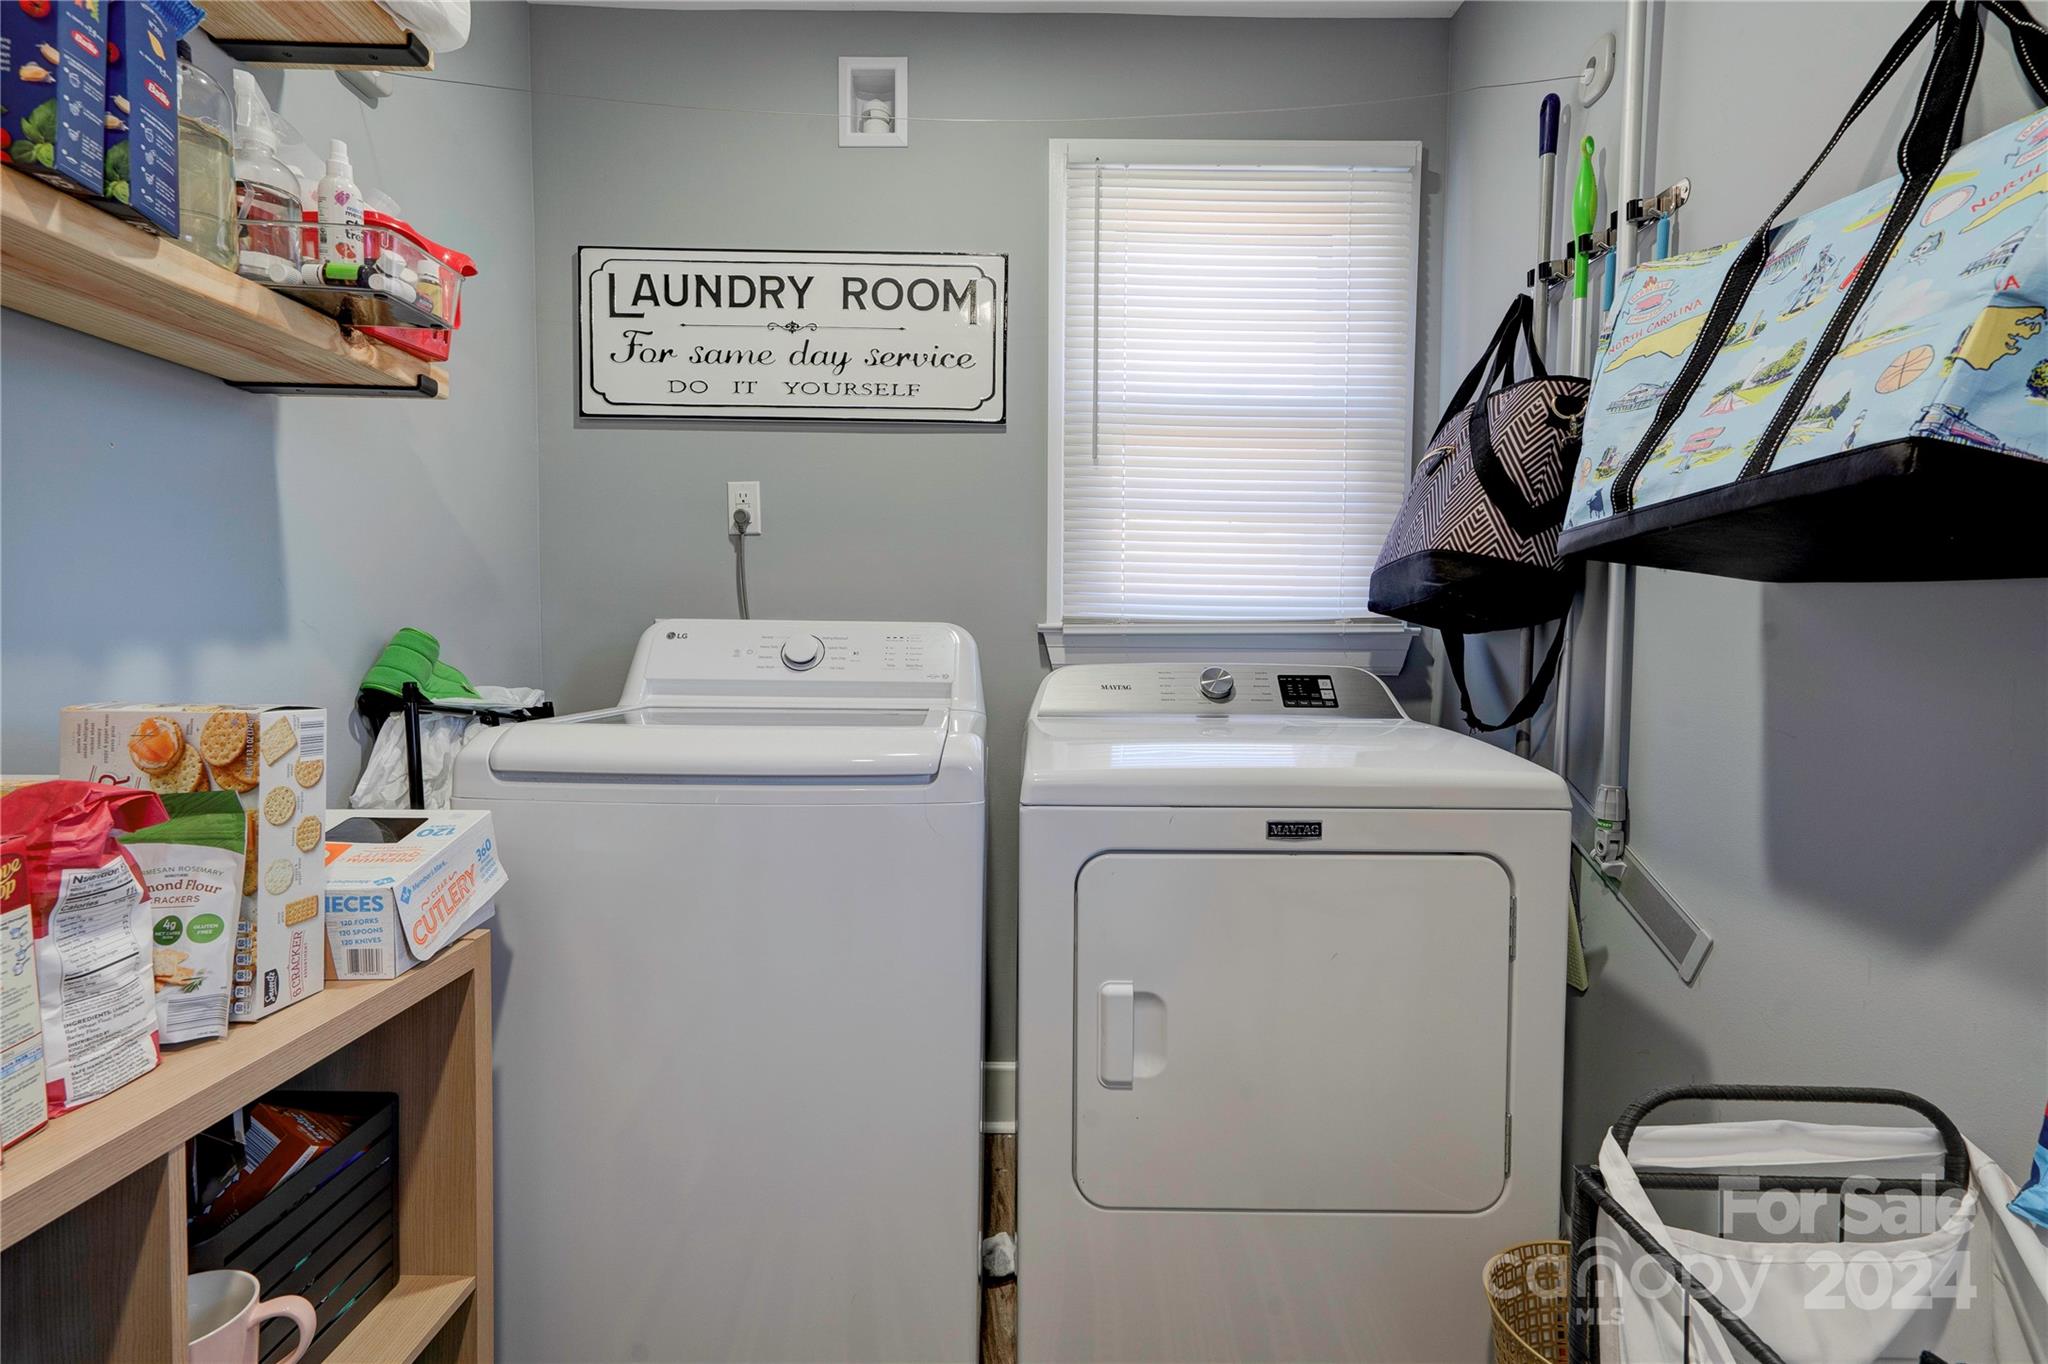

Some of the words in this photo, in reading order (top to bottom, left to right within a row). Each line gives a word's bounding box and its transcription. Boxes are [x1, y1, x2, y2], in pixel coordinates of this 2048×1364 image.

[608, 272, 814, 318] LAUNDRY
[842, 277, 978, 325] ROOM
[1647, 299, 1703, 333] CAROLINA
[609, 330, 678, 364] For
[689, 345, 776, 366] same
[788, 339, 852, 376] day
[864, 345, 977, 369] service
[667, 380, 708, 394] DO
[732, 380, 758, 394] IT
[784, 381, 921, 397] YOURSELF
[1270, 825, 1320, 836] MAYTAG
[142, 866, 175, 875] MESAN
[178, 865, 224, 876] ROSEMARY
[147, 879, 183, 893] mond
[185, 880, 222, 894] Flour
[150, 895, 200, 904] RACKERS
[325, 895, 385, 913] IECES
[412, 863, 477, 946] CUTLERY
[163, 919, 177, 931] 4g
[354, 918, 379, 926] FORKS
[353, 927, 383, 935] SPOONS
[354, 937, 381, 945] KNIVES
[291, 931, 303, 988] CRACKER
